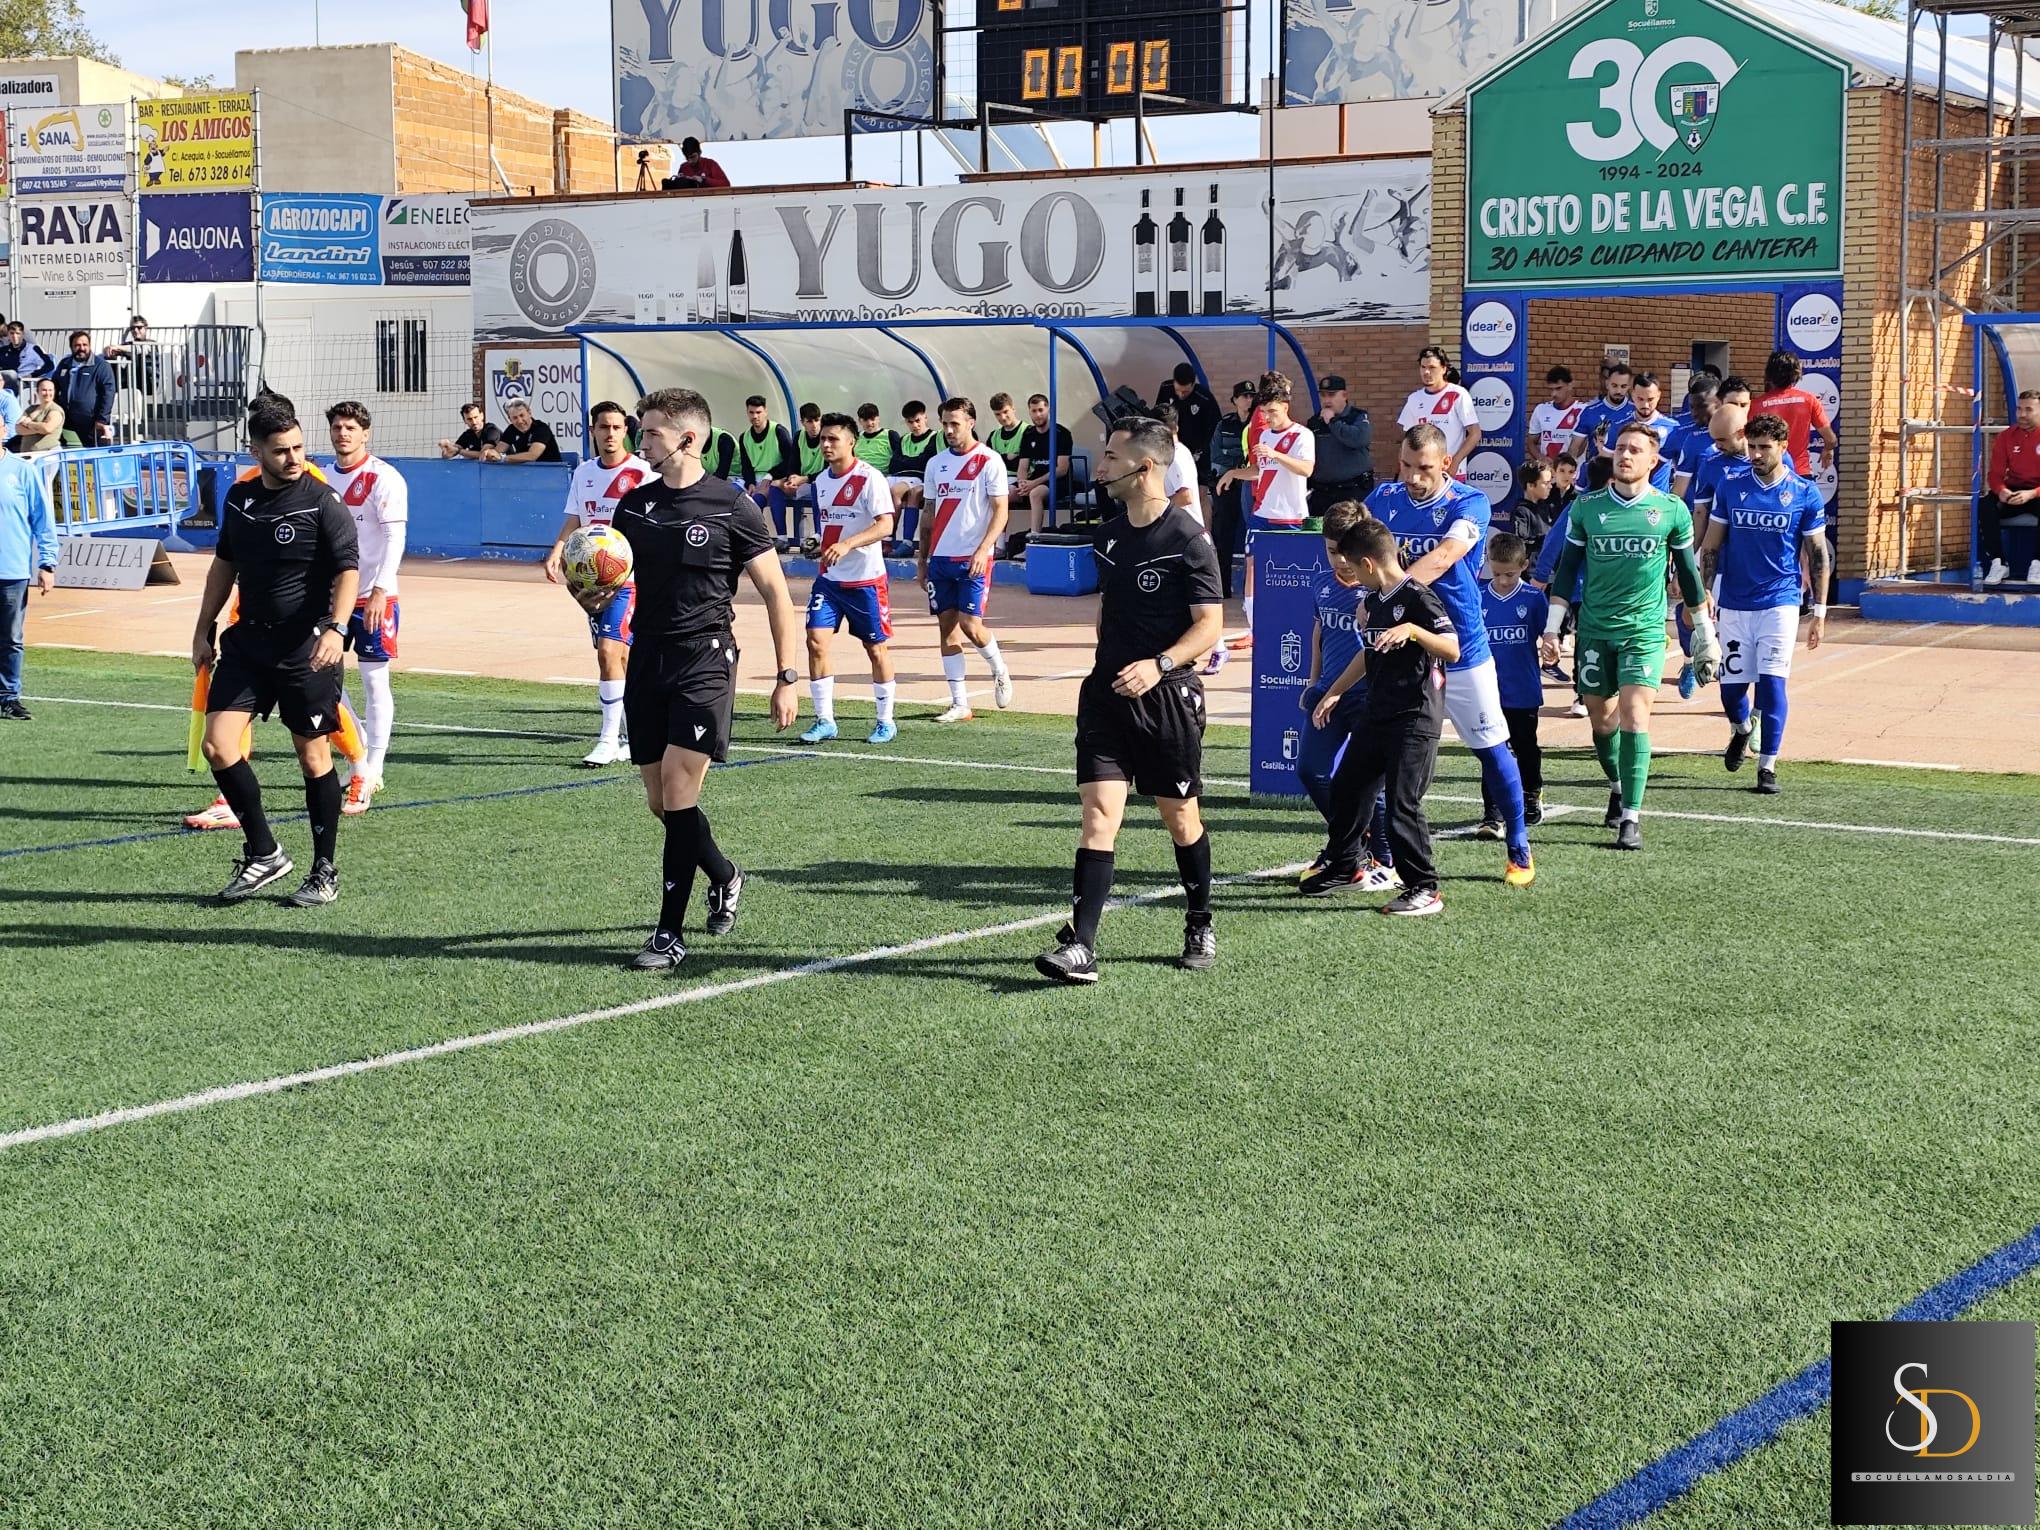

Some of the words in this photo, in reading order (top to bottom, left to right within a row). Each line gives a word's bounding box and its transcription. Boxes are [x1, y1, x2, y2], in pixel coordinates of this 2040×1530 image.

[139, 105, 154, 117] BAR
[161, 101, 211, 116] RESTAURANTE
[218, 98, 251, 112] TERRAZA
[161, 120, 188, 142] LOS
[191, 116, 251, 141] AMIGOS
[169, 168, 185, 182] Tel.
[188, 167, 207, 180] 673
[210, 166, 229, 179] 328
[232, 165, 251, 179] 614
[1600, 166, 1640, 181] 1994
[1657, 162, 1702, 178] 2024
[270, 207, 367, 232] AGROZOCAPI
[1480, 194, 1583, 239] CRISTO
[1591, 191, 1632, 233] DE
[1639, 189, 1677, 232] LA
[1682, 185, 1768, 229] VEGA
[1776, 182, 1828, 227] C.F.
[20, 204, 123, 245] RAYA
[165, 226, 244, 250] AQUONA
[388, 241, 446, 250] INSTALACIONES
[775, 191, 1106, 301] YUGO
[20, 252, 124, 265] INTERMEDIARIOS
[1488, 247, 1517, 271] 30
[1524, 240, 1582, 268] AÑOS
[1590, 240, 1705, 265] CUIDANDO
[1712, 236, 1818, 261] CANTERA
[389, 260, 414, 270] Jesús
[422, 261, 438, 269] 607
[440, 261, 456, 269] 522
[42, 270, 65, 282] Wine
[67, 270, 74, 281] &
[76, 269, 104, 283] Spirits
[1735, 511, 1788, 528] YUGO
[1595, 538, 1656, 553] YUGO
[59, 543, 143, 568] AUTELA
[1265, 579, 1299, 587] CIUDAD
